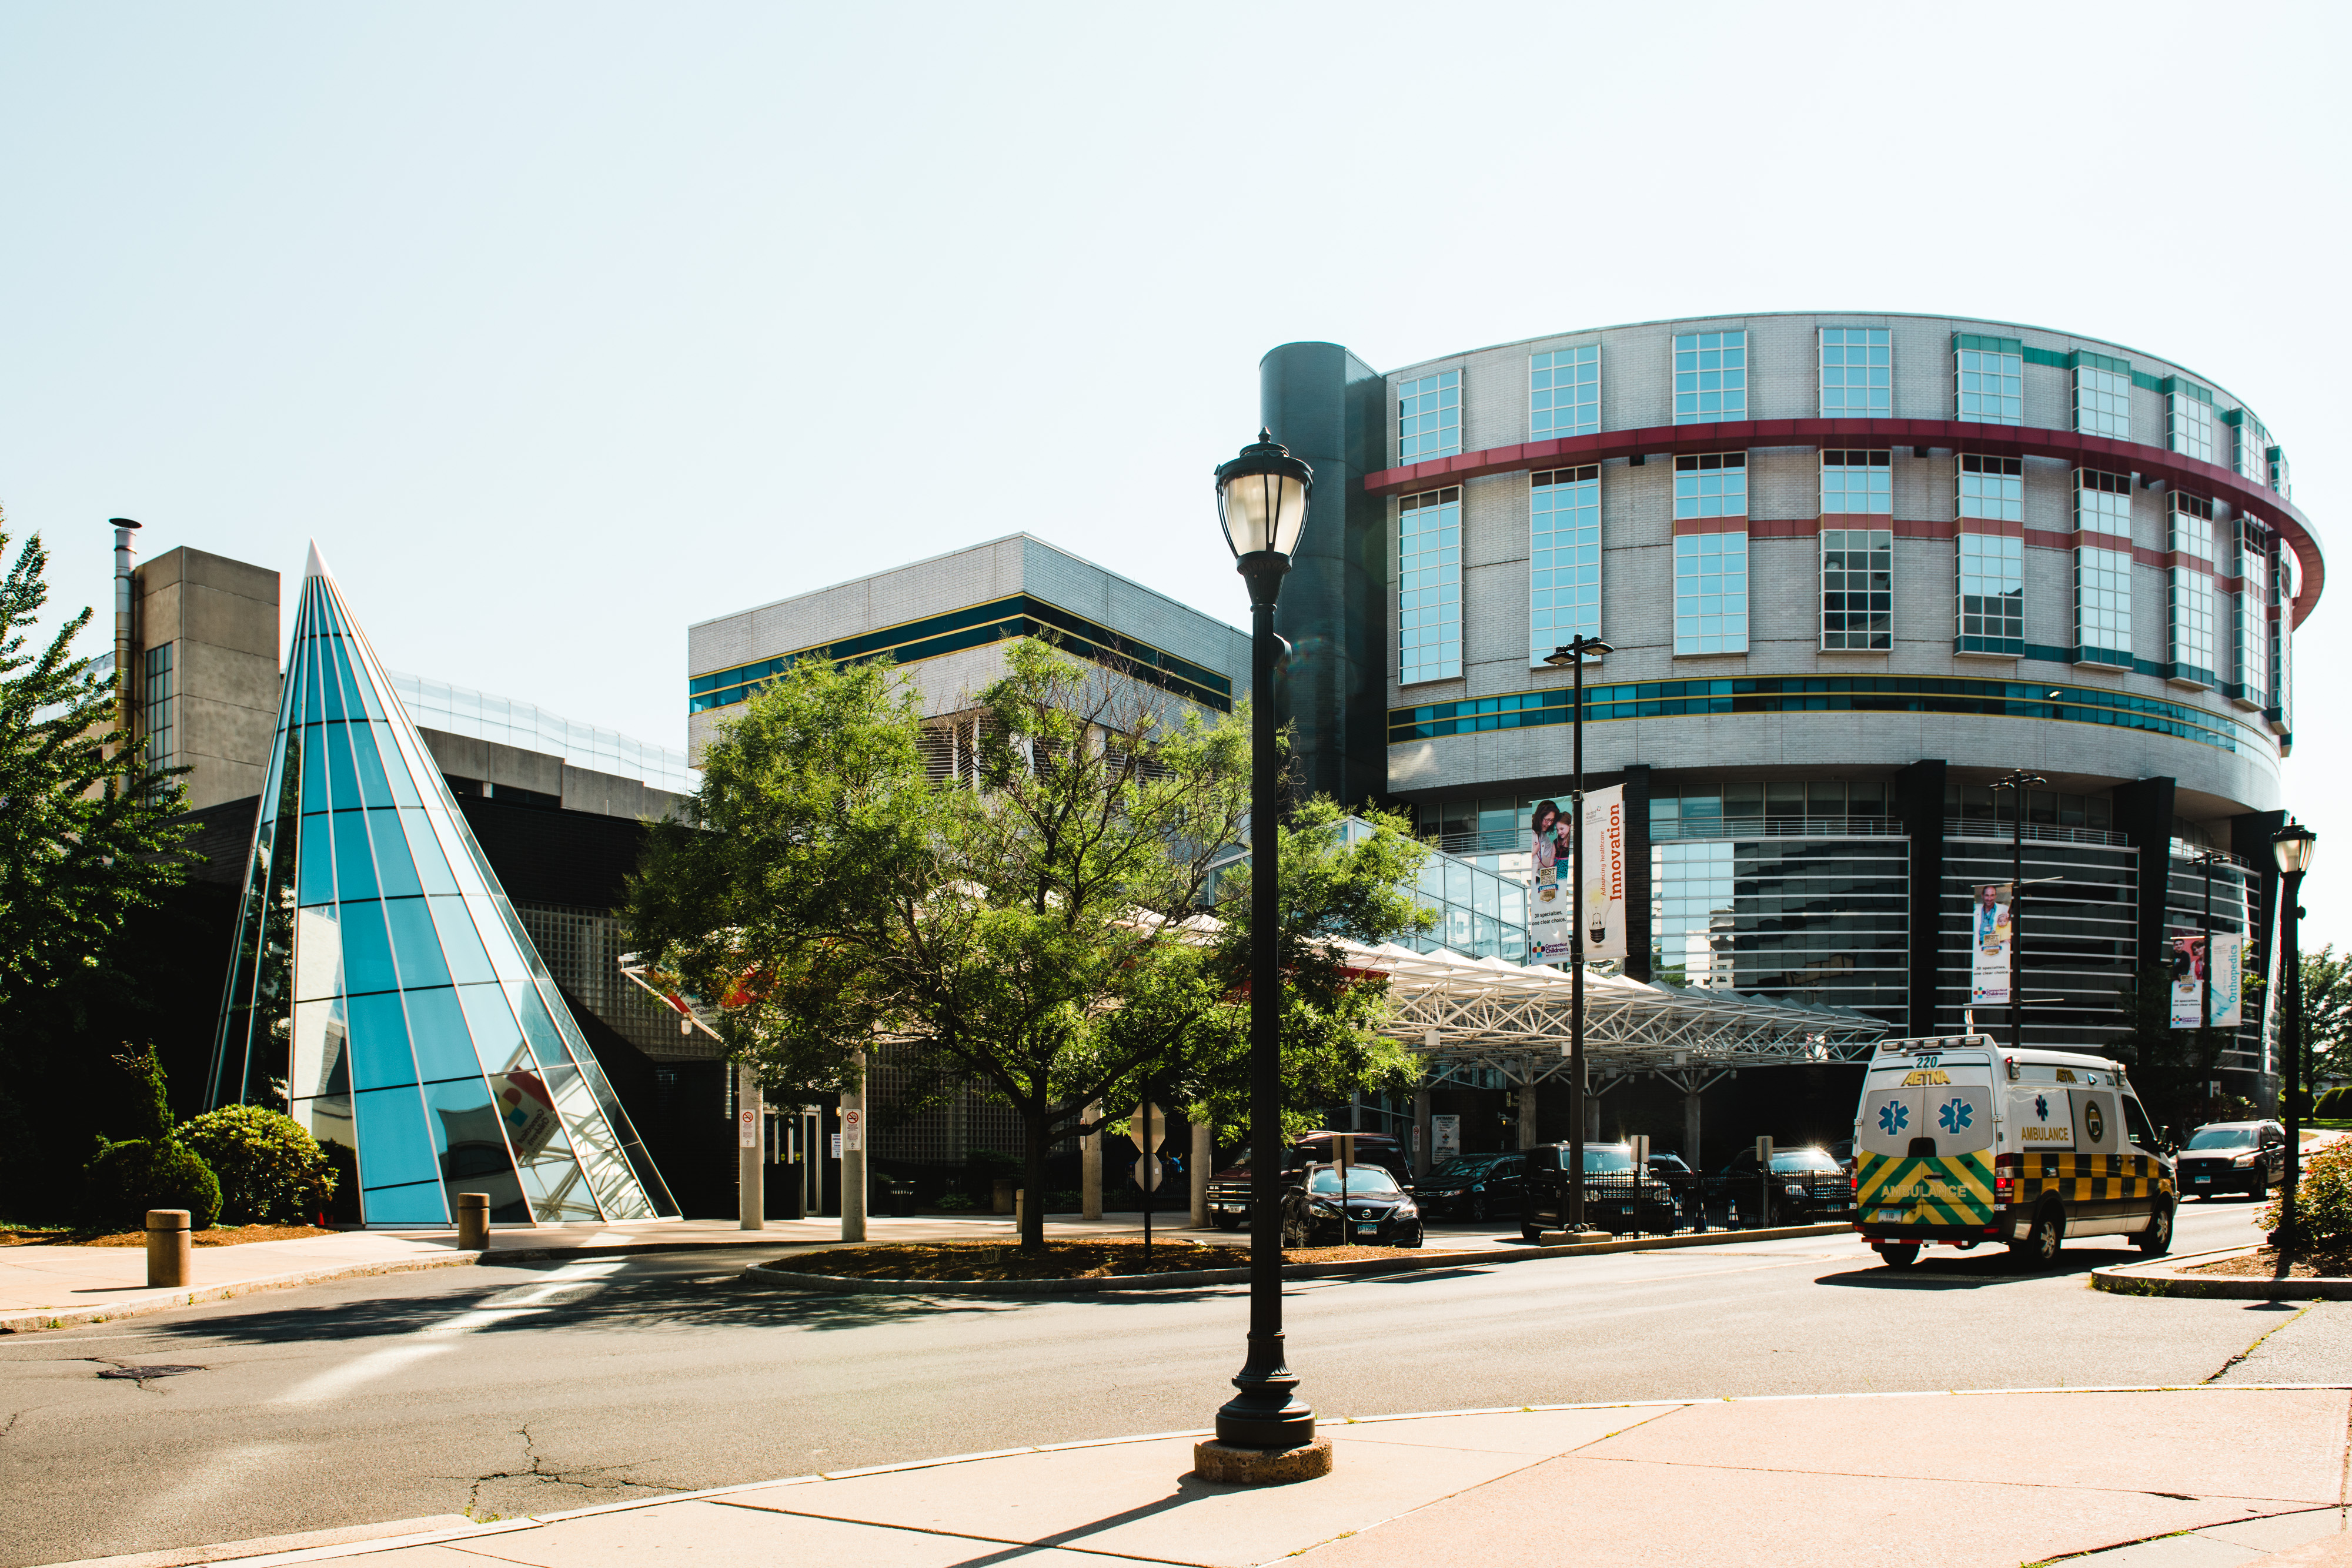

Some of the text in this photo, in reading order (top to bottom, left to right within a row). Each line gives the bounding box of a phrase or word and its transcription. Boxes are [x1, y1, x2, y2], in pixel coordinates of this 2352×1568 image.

[1607, 803, 1622, 901] Innovation
[2228, 944, 2239, 1003] Orthopedics
[1916, 1056, 1937, 1068] 220
[1900, 1070, 1951, 1086] AETNA
[2056, 1069, 2077, 1084] AETNA
[2022, 1127, 2069, 1141] AMBULANCE
[1881, 1185, 1966, 1197] AMBULANCE
